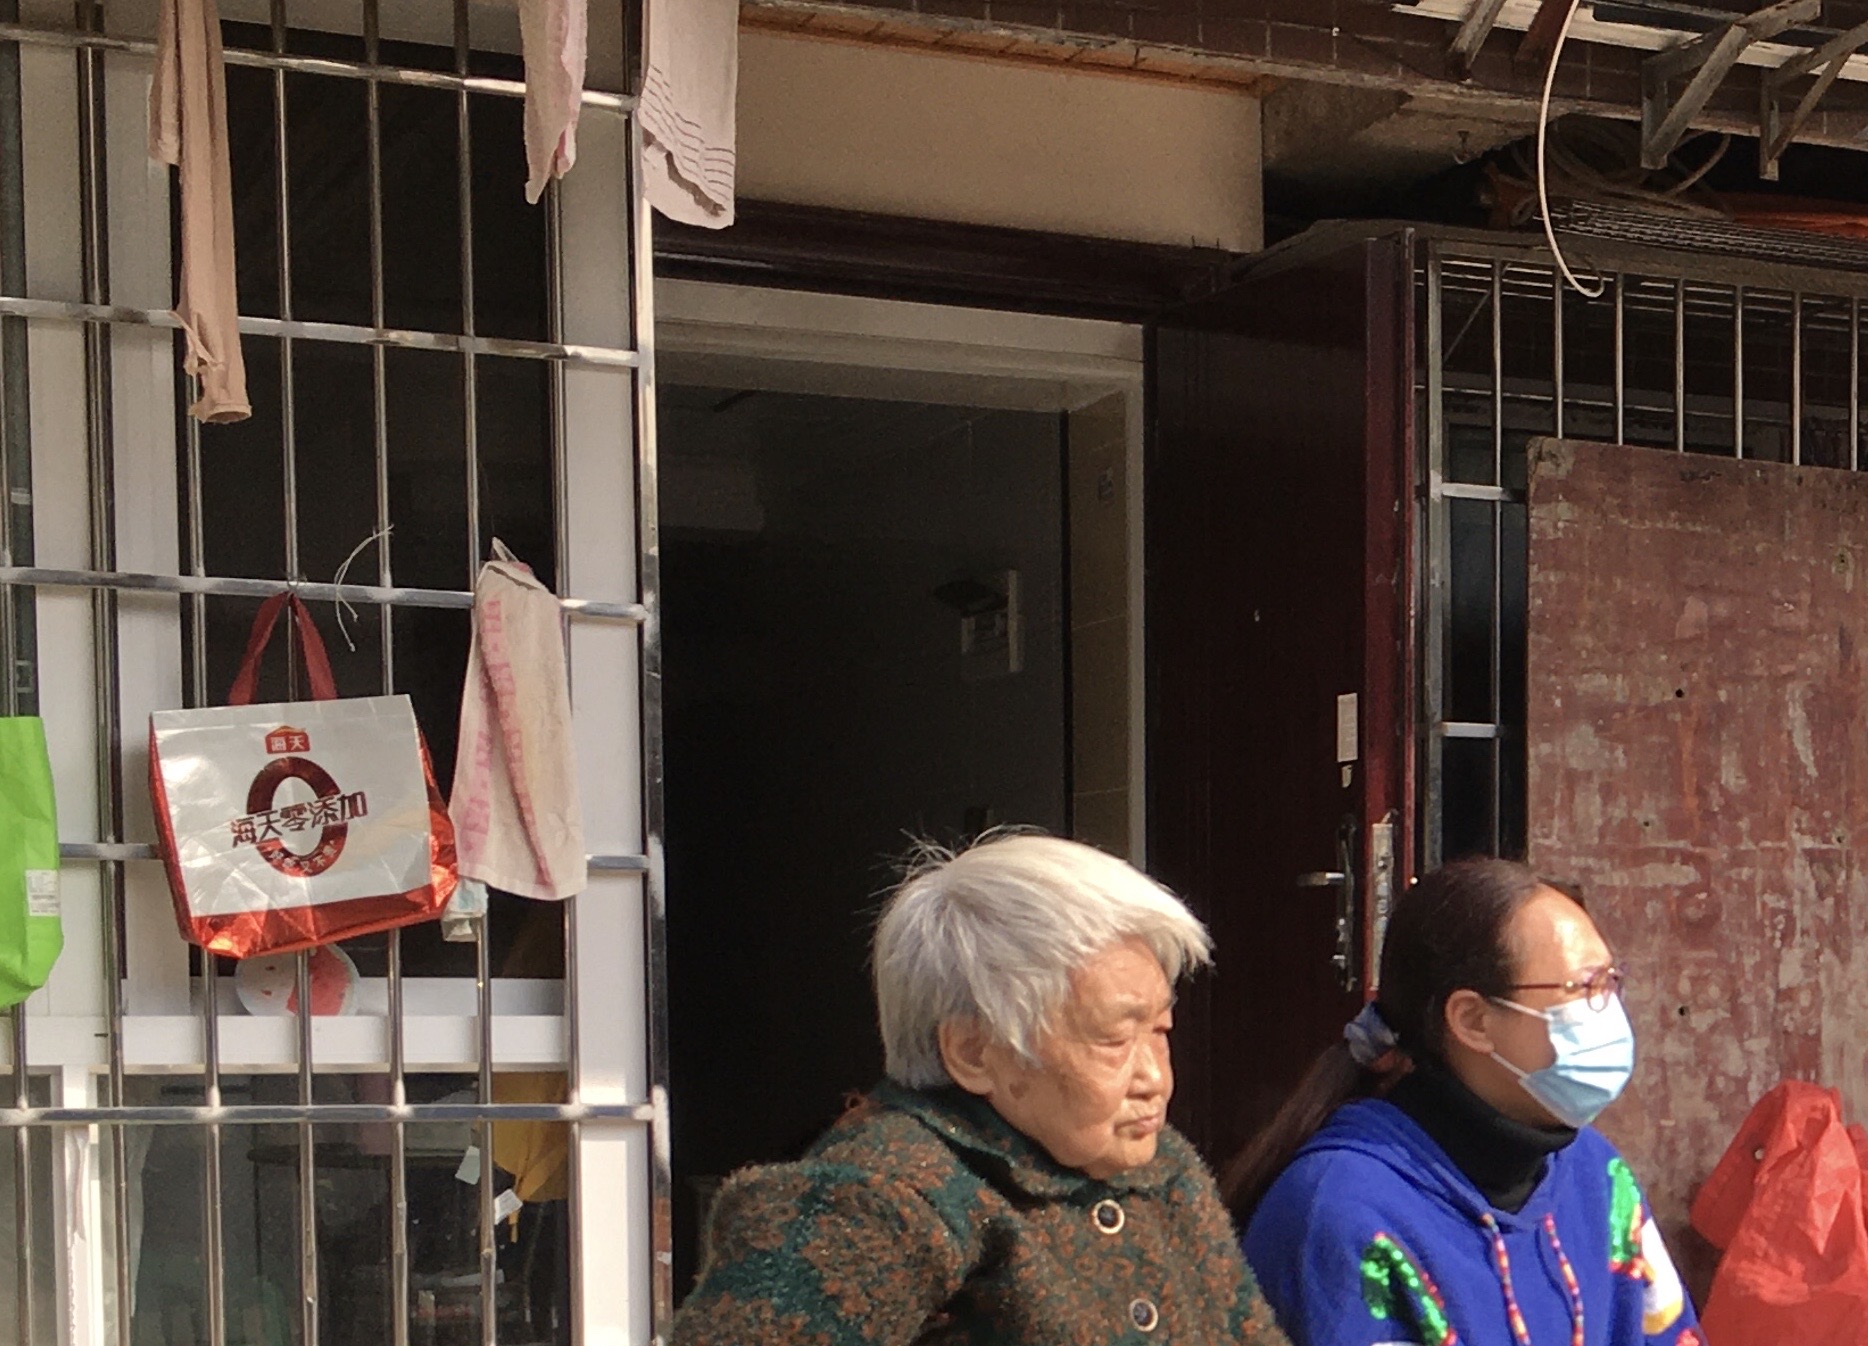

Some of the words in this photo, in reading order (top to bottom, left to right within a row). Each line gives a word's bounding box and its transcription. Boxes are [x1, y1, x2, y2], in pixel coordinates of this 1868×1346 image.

[231, 791, 368, 848] 海天零添加
